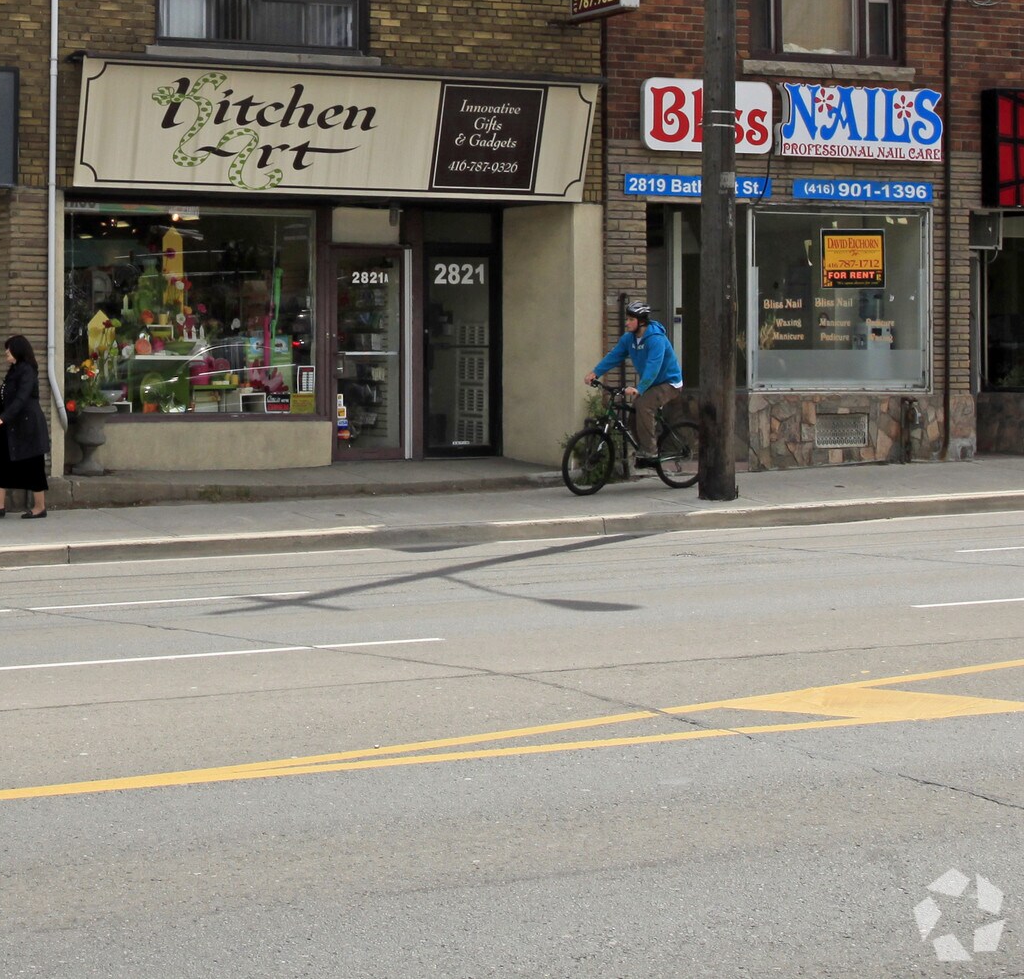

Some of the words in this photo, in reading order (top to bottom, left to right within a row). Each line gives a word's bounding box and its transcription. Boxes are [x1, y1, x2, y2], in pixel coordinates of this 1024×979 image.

[152, 72, 378, 147] Kitchen
[460, 99, 522, 115] Innovative
[650, 86, 769, 145] Bls
[783, 83, 942, 145] NAILS
[473, 115, 503, 133] Gifts
[455, 132, 466, 147] &
[469, 132, 517, 151] Gadgets
[782, 142, 874, 158] PROFESSIONAL
[876, 146, 906, 159] NAIL
[908, 148, 941, 161] CARE
[448, 159, 518, 174] 416-787-9326
[629, 177, 666, 192] 2819
[671, 179, 738, 195] Batt
[742, 180, 763, 195] St.
[804, 181, 835, 196] (416)
[838, 182, 927, 199] 901-1396
[838, 259, 880, 268] 787-1712
[434, 263, 485, 285] 2821
[828, 271, 847, 279] FOR
[849, 271, 875, 279] RENT
[784, 298, 803, 309] Nail
[835, 297, 854, 308] Nail
